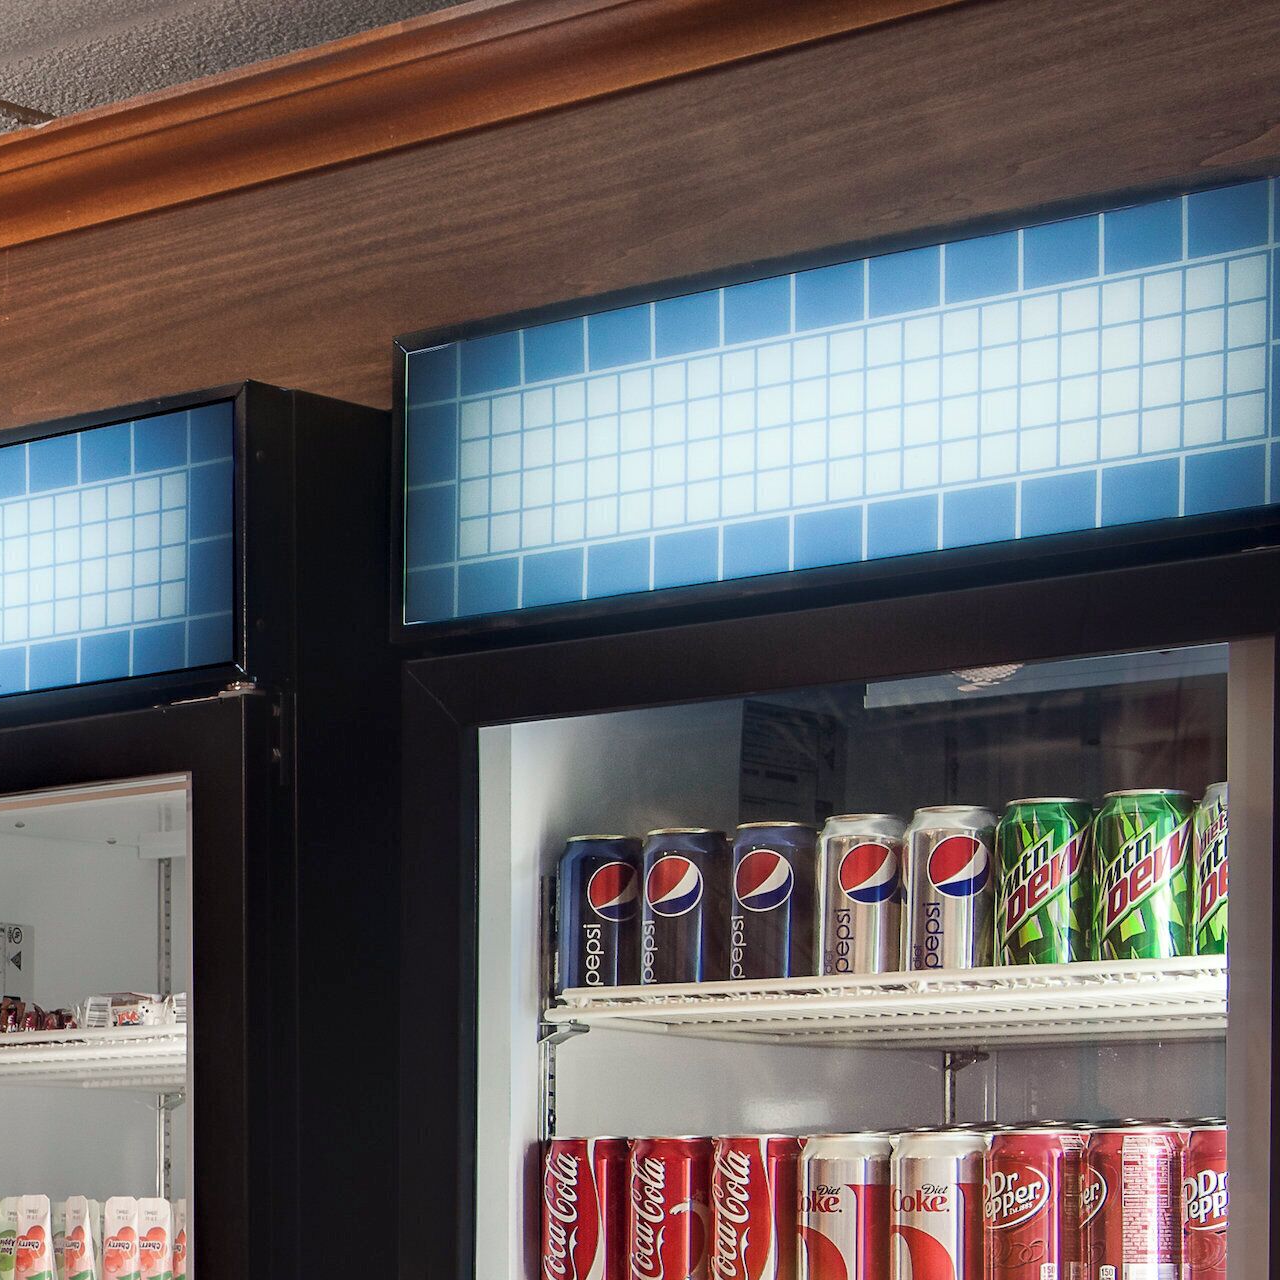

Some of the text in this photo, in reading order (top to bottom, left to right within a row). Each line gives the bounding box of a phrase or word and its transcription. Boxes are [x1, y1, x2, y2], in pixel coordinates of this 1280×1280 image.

[1004, 838, 1049, 892] Mtn
[1006, 824, 1090, 932] Dew
[1105, 832, 1154, 882] Mtn
[1107, 816, 1191, 928] Dew
[583, 923, 604, 986] pepsi
[642, 919, 658, 983] pepsi
[730, 915, 747, 979] pepsi
[834, 908, 853, 974] pepsi
[922, 902, 943, 969] pepsi
[816, 1184, 840, 1195] Diet
[892, 1188, 950, 1213] Coke
[921, 1183, 948, 1195] Diet
[992, 1171, 1019, 1198] Dr
[17, 1239, 40, 1248] Cherry
[107, 1239, 131, 1249] Cherry
[1100, 1265, 1114, 1276] 150
